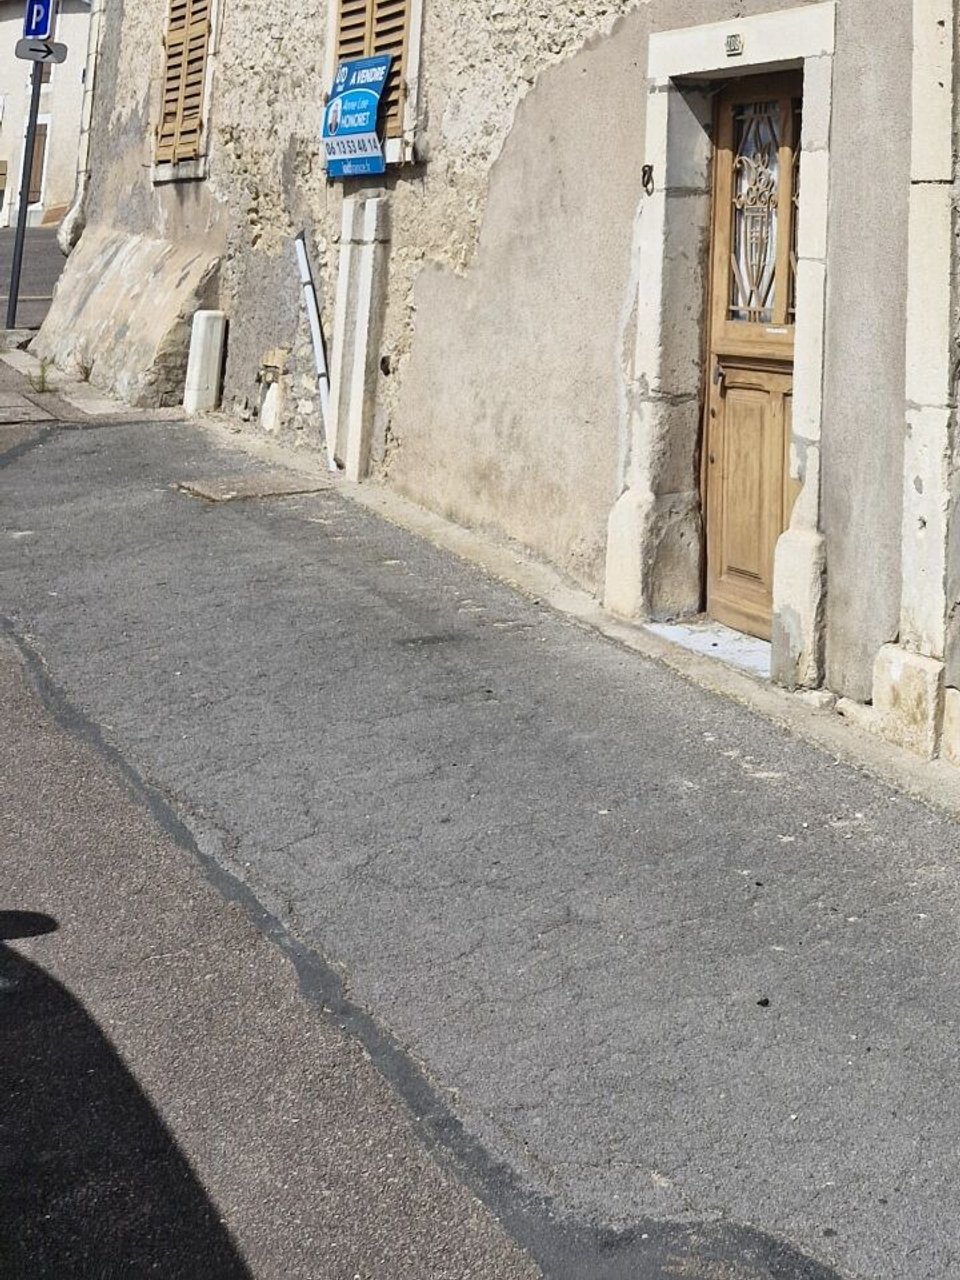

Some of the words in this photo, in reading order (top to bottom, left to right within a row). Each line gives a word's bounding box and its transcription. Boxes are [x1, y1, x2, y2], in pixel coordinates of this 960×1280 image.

[31, 4, 45, 30] P
[357, 65, 387, 84] VENDRE
[325, 141, 336, 156] 06
[336, 140, 346, 155] 13
[368, 137, 379, 152] 14
